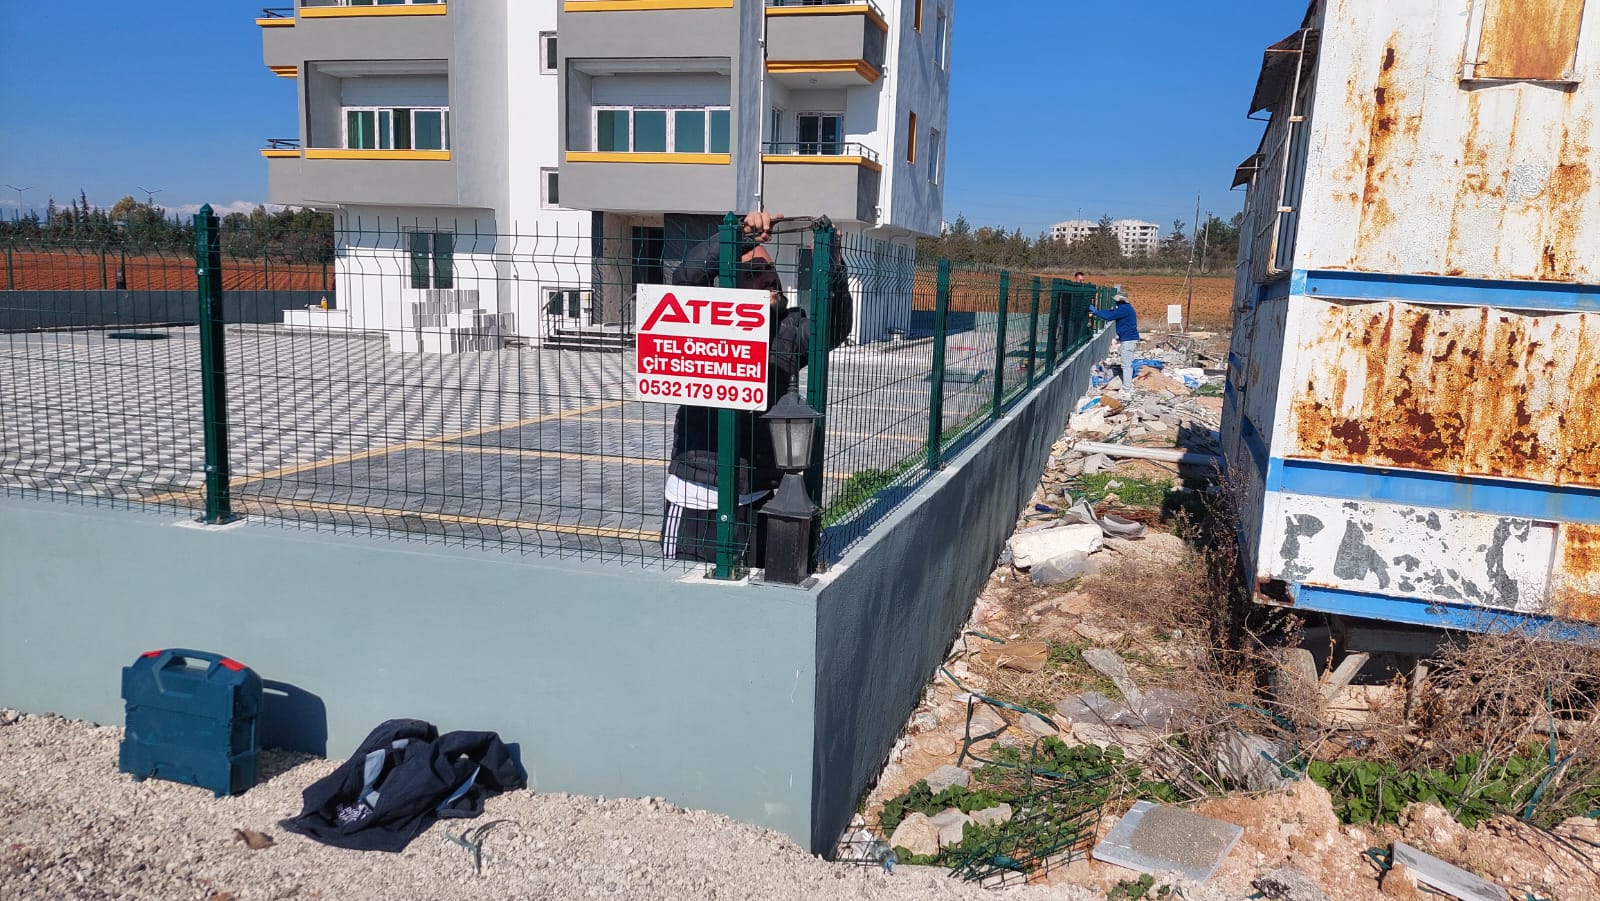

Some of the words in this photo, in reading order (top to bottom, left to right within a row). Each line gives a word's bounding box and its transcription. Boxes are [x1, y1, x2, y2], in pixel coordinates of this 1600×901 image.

[640, 292, 765, 331] ATEŞ
[653, 339, 681, 354] TEL
[684, 338, 728, 357] ÖRGÜ
[731, 345, 751, 359] VE
[642, 354, 668, 374] ÇİT
[670, 356, 761, 378] SİSTEMLERİ
[639, 379, 682, 397] 0532
[685, 383, 713, 399] 179
[716, 385, 739, 401] 99
[742, 387, 764, 404] 30
